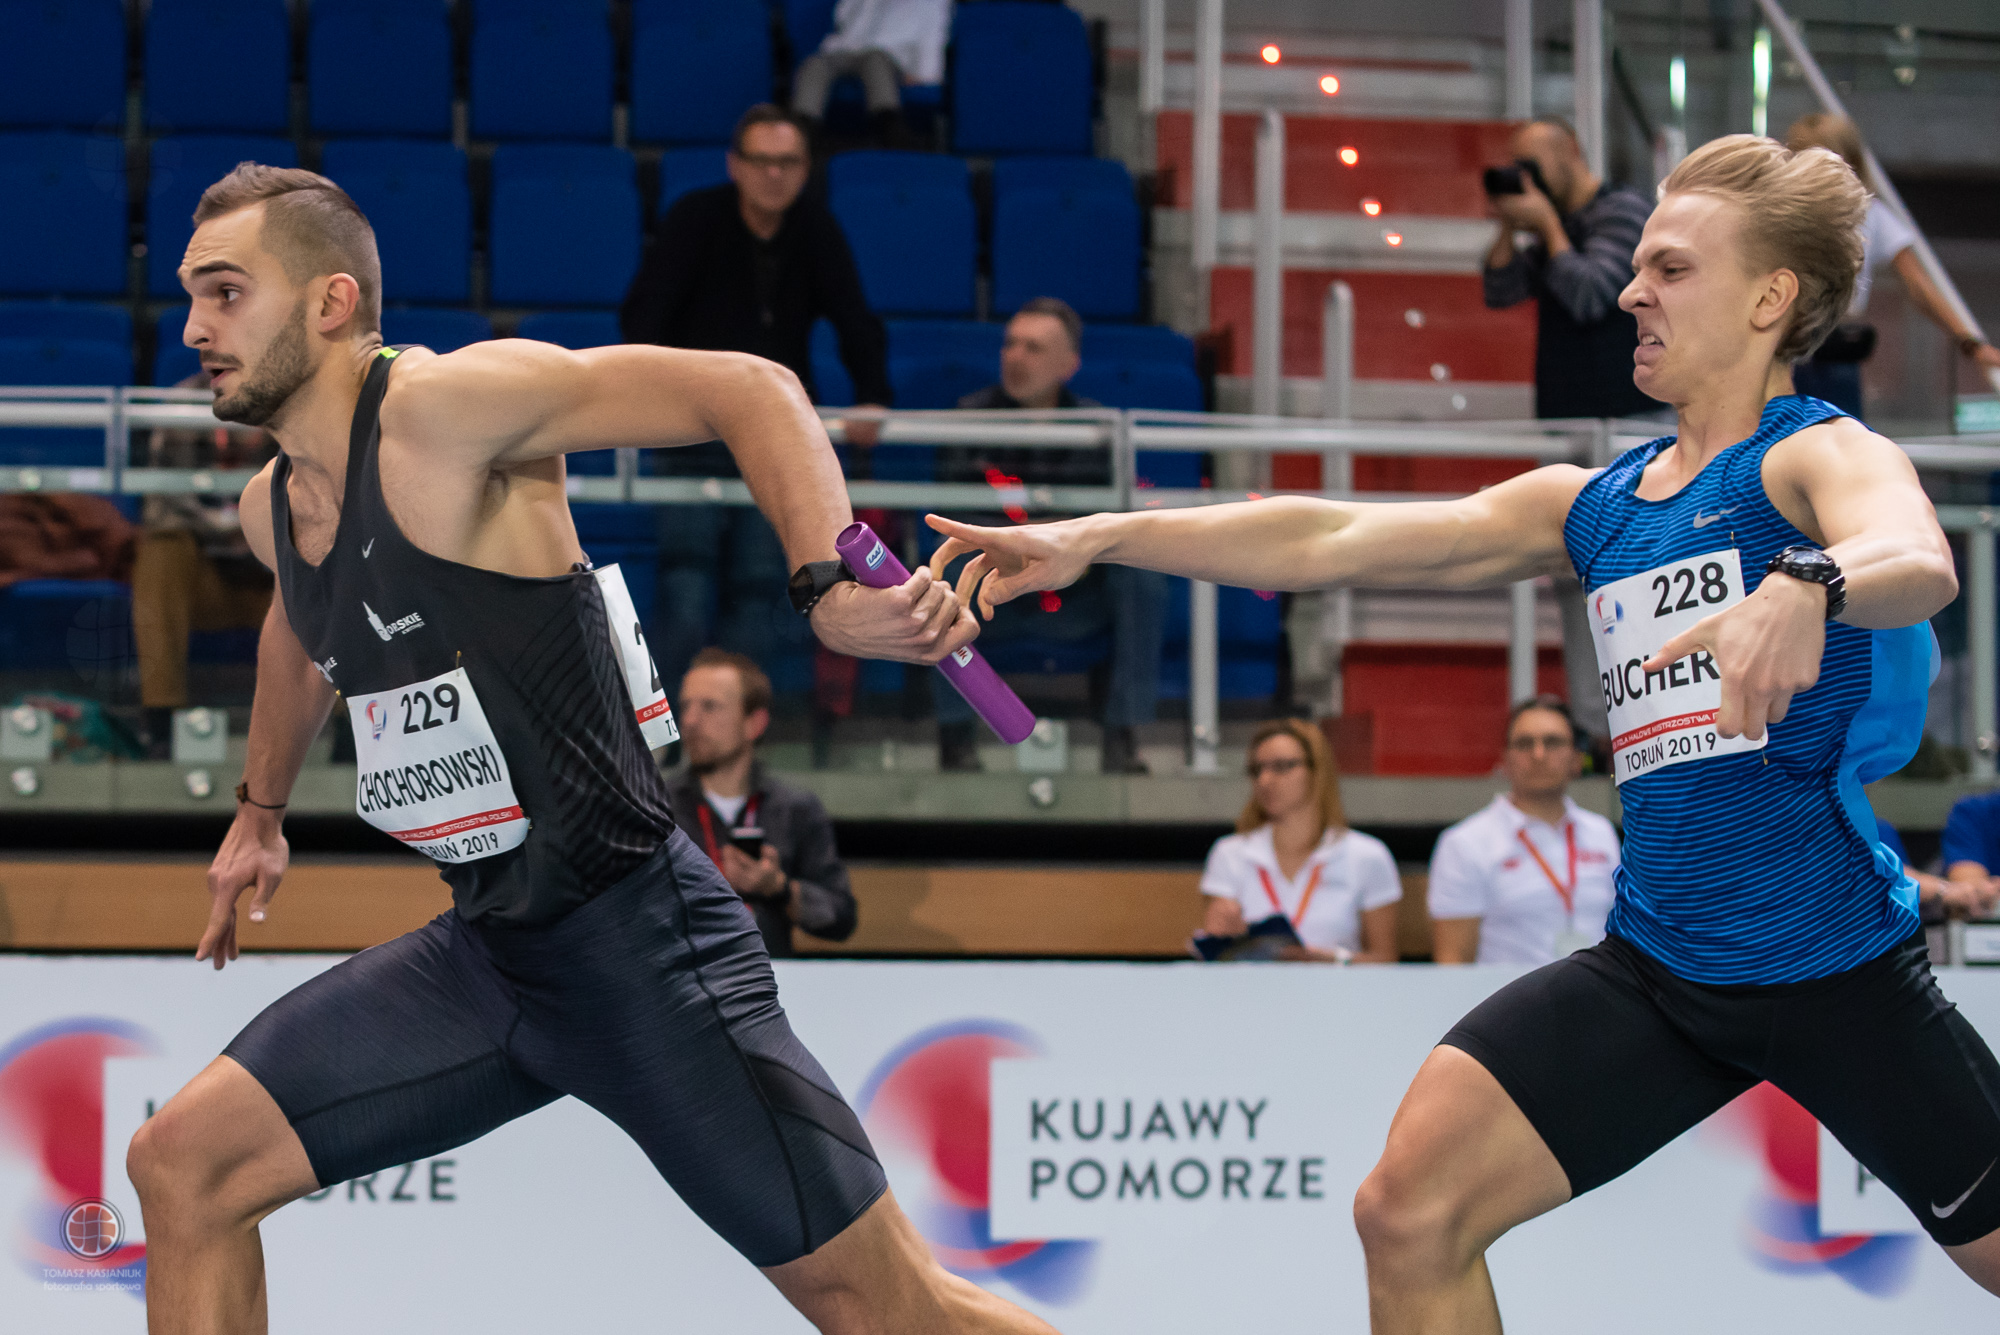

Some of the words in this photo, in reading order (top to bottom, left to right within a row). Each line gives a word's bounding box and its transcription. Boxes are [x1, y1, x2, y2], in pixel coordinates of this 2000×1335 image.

[1652, 562, 1728, 618] 228
[400, 683, 460, 734] 229
[1628, 727, 1652, 743] HALOWE
[1651, 714, 1711, 733] MISTRZOSTWA
[1624, 737, 1664, 773] TORUŃ
[1668, 732, 1717, 758] 2019
[359, 744, 502, 813] CHOCHOROWSKI
[435, 816, 489, 834] MISTRZOSTWA
[488, 810, 514, 821] POLSKI
[462, 831, 499, 856] 2019
[1030, 1098, 1267, 1141] KUJAWY
[1030, 1158, 1325, 1201] POMORZE
